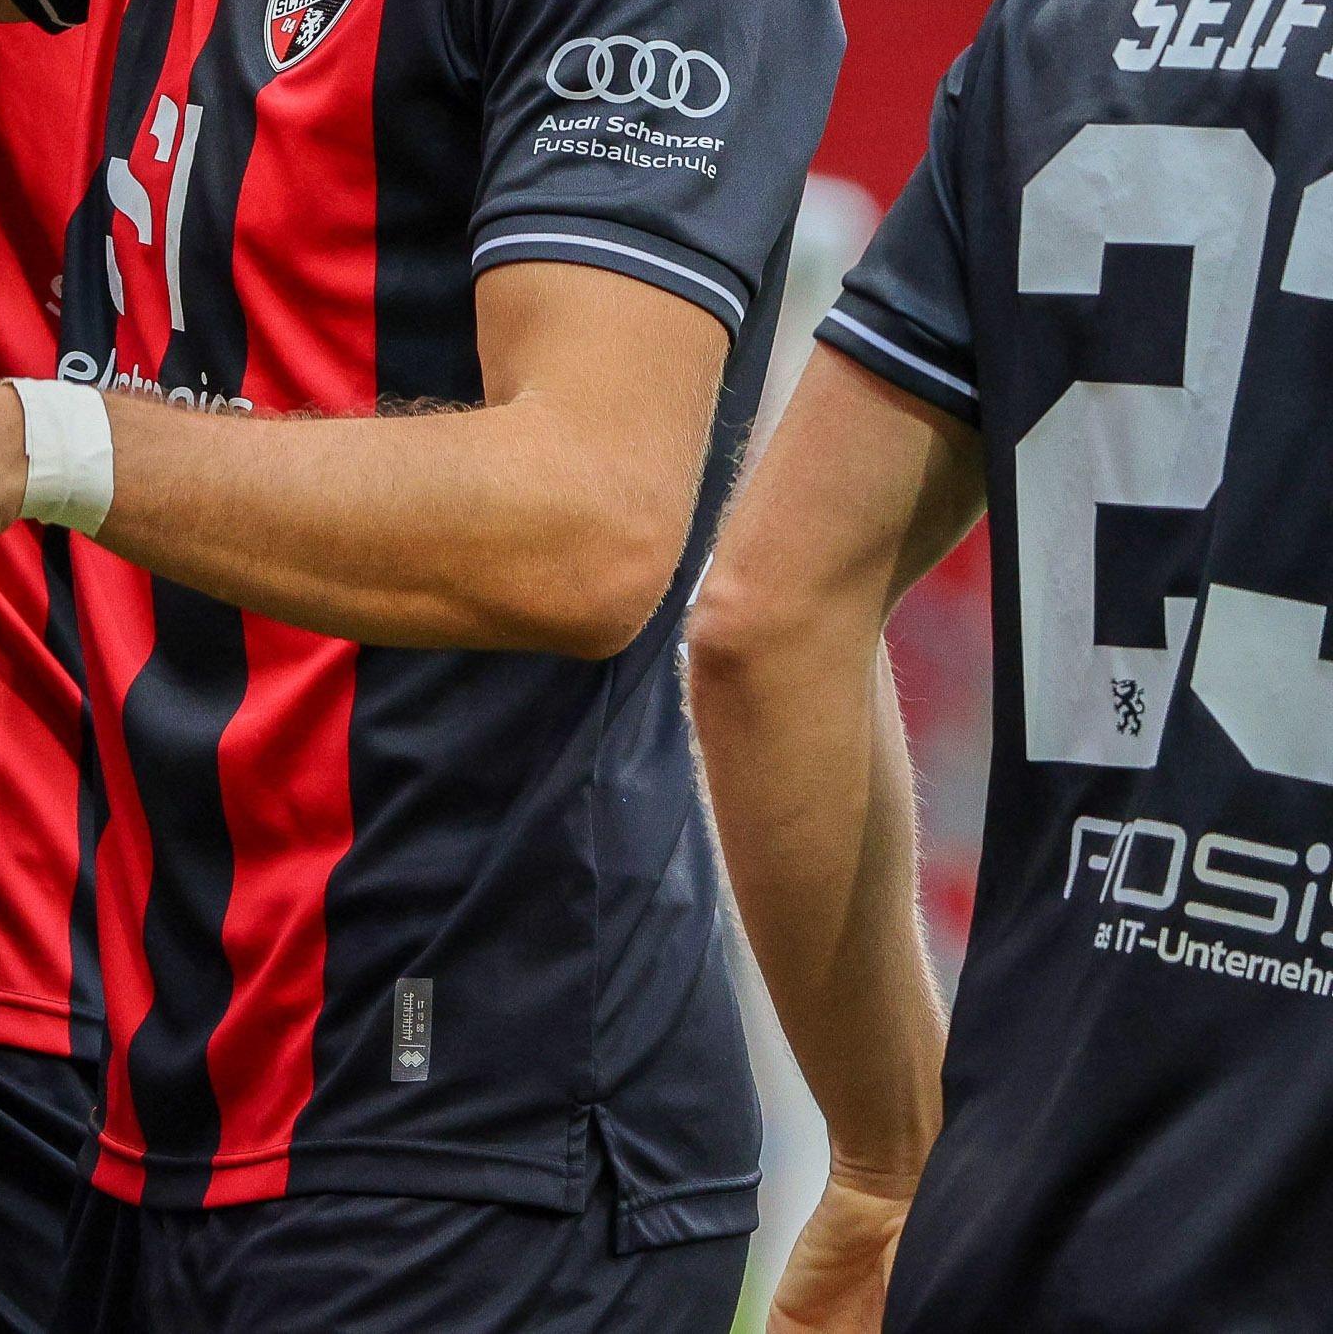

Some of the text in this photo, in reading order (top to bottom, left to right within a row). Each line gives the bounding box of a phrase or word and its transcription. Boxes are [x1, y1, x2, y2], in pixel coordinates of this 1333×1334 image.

[280, 17, 296, 34] 04
[537, 114, 725, 152] Audi Schanzer
[533, 137, 717, 179] Fussballschule
